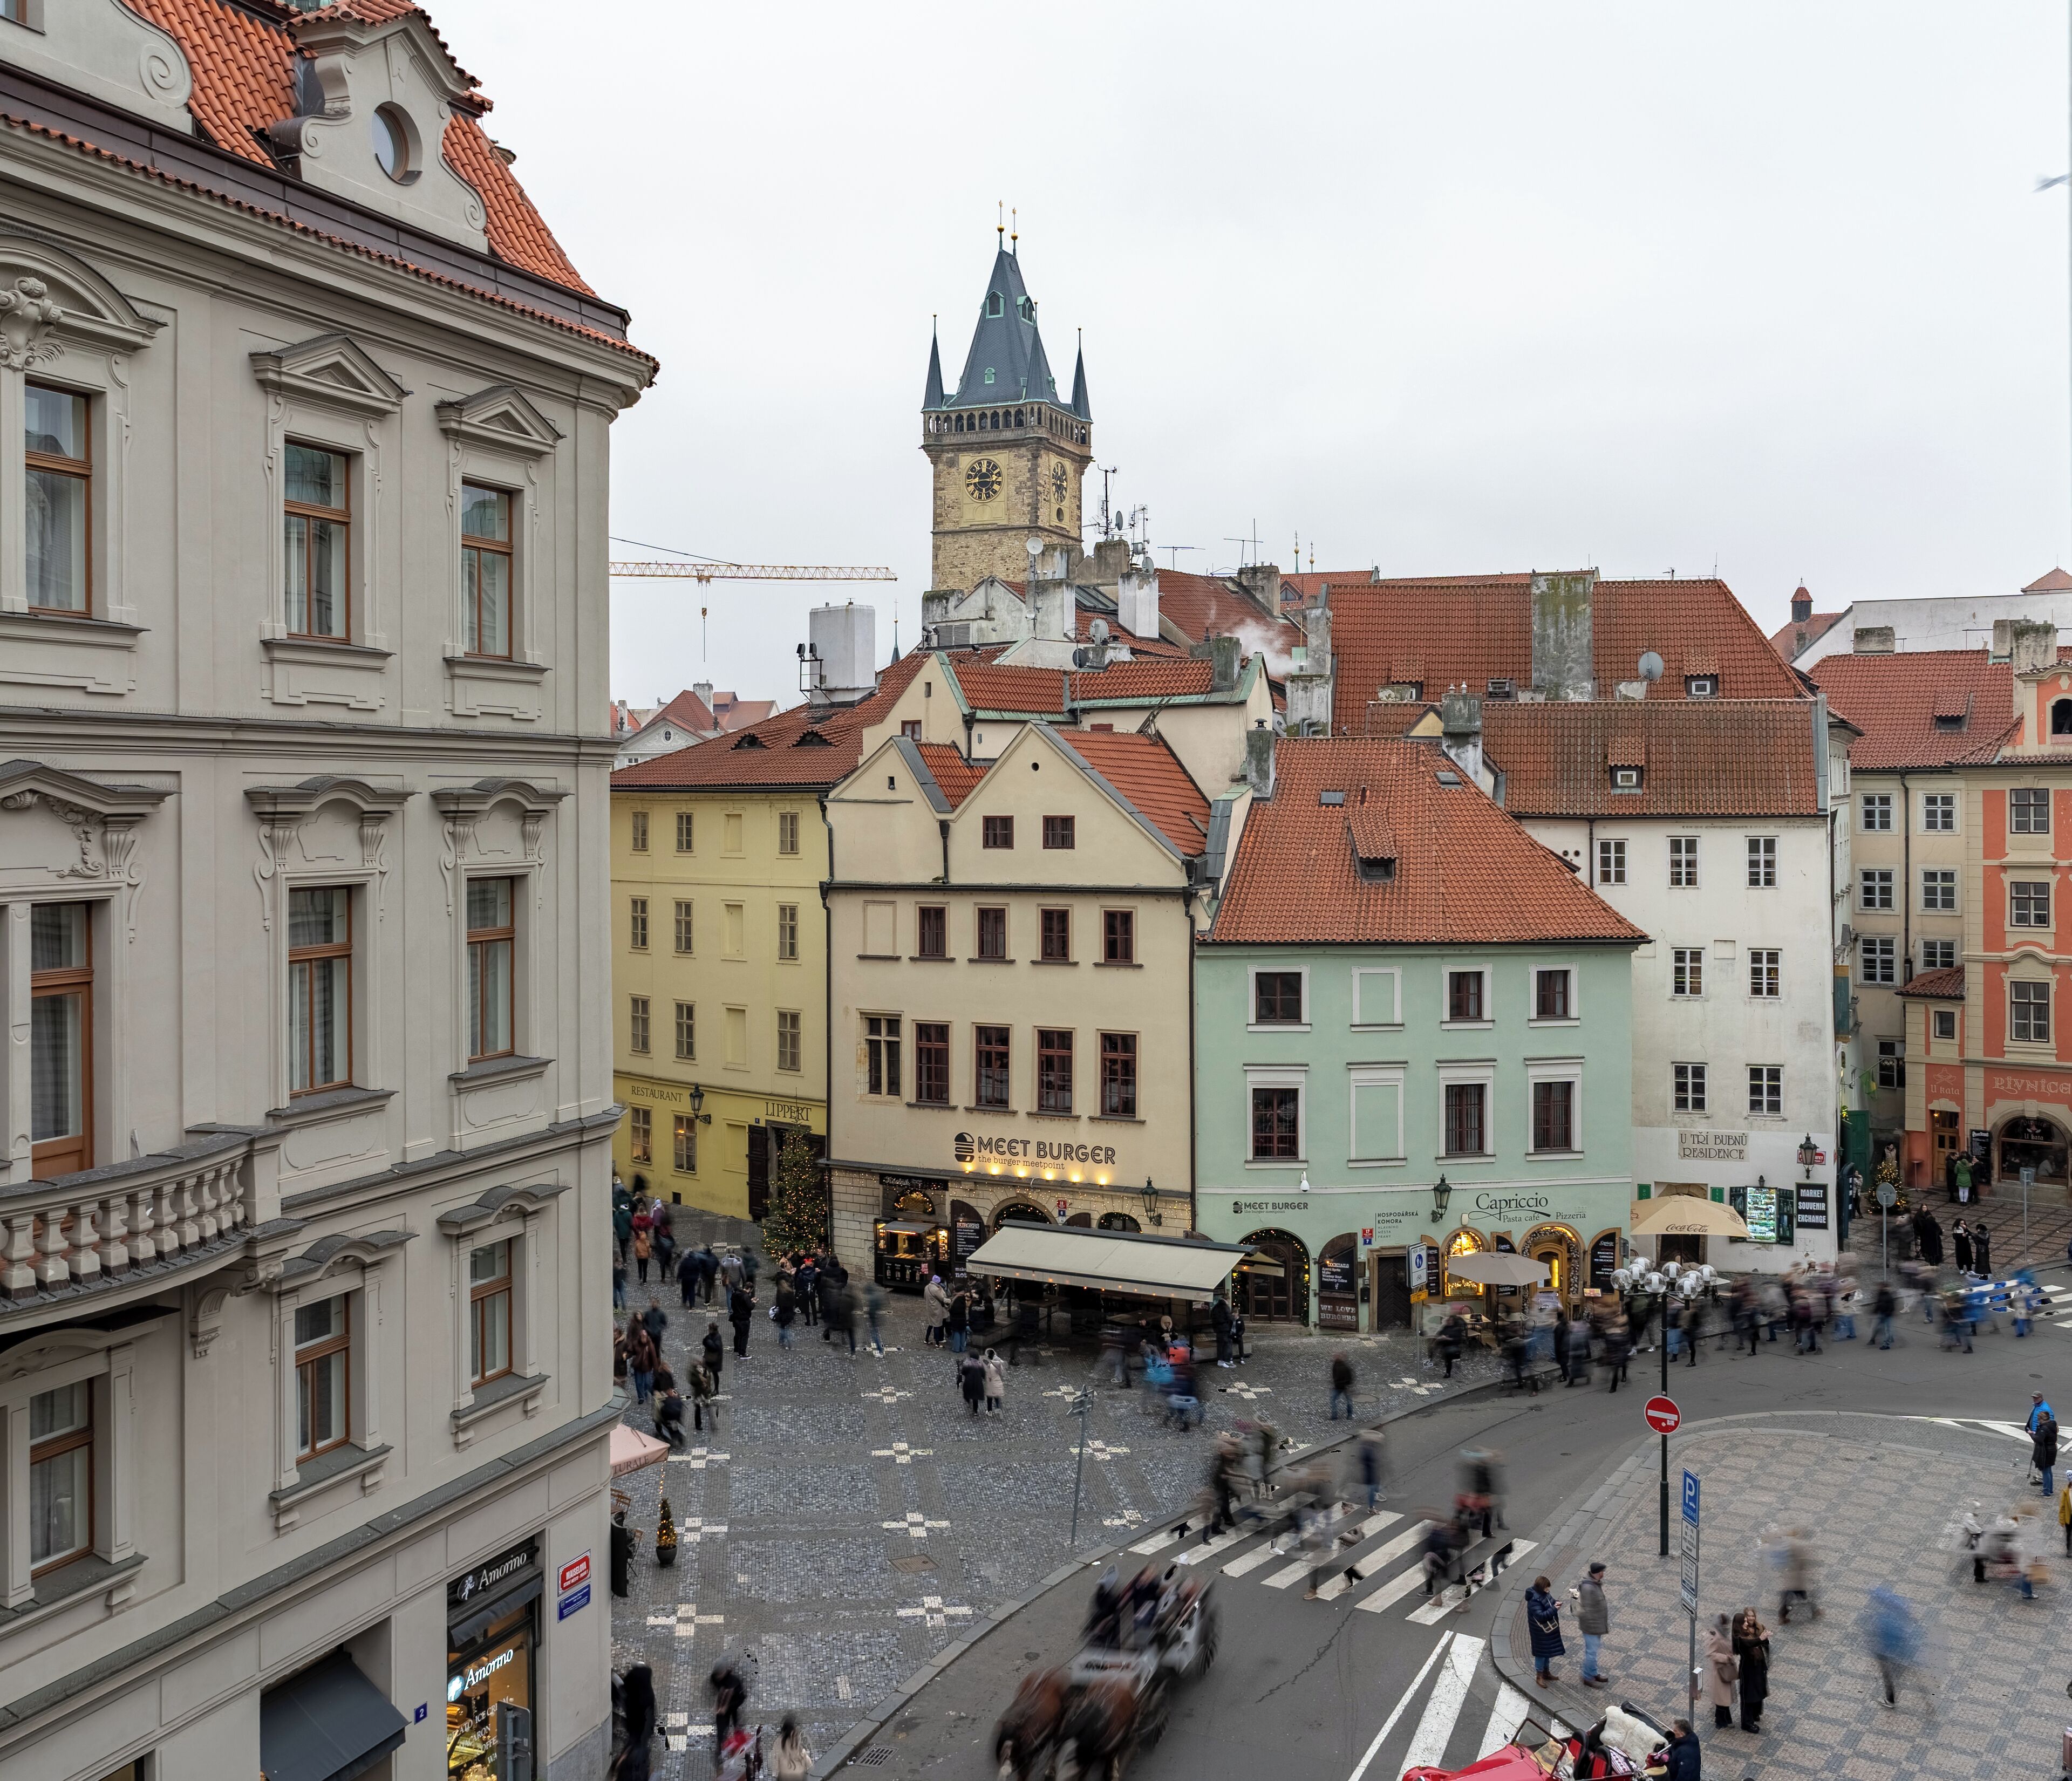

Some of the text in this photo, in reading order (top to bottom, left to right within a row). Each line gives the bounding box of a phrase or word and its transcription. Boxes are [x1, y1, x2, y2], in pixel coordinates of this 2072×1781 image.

[631, 1086, 683, 1102] RESTAURANT
[1940, 1086, 1960, 1095] kata
[765, 1102, 812, 1121] LIPPERT
[1680, 1131, 1747, 1146] U TŘÍ BUBNŮ
[978, 1136, 1116, 1165] MEET BURGER
[1683, 1147, 1744, 1159] RESIDENCE
[993, 1157, 1021, 1166] burger
[1023, 1160, 1065, 1170] meetpoint
[1800, 1189, 1823, 1198] MARKET
[1272, 1202, 1308, 1210] BURGER
[1476, 1192, 1549, 1220] Capriccio
[1798, 1202, 1825, 1211] SOUVENIR
[1503, 1212, 1586, 1223] Pasta café Pizzeria
[1798, 1214, 1826, 1224] EXCHANGE
[1665, 1224, 1710, 1233] Coca-Cola
[1320, 1313, 1356, 1321] BURGERS
[612, 1455, 650, 1475] TURALE
[1685, 1476, 1695, 1504] P
[478, 1552, 527, 1590] Amorino
[565, 1561, 587, 1581] MAISELOVA
[464, 1648, 514, 1691] Amorino
[419, 1708, 424, 1718] 2
[475, 1711, 486, 1724] ICE
